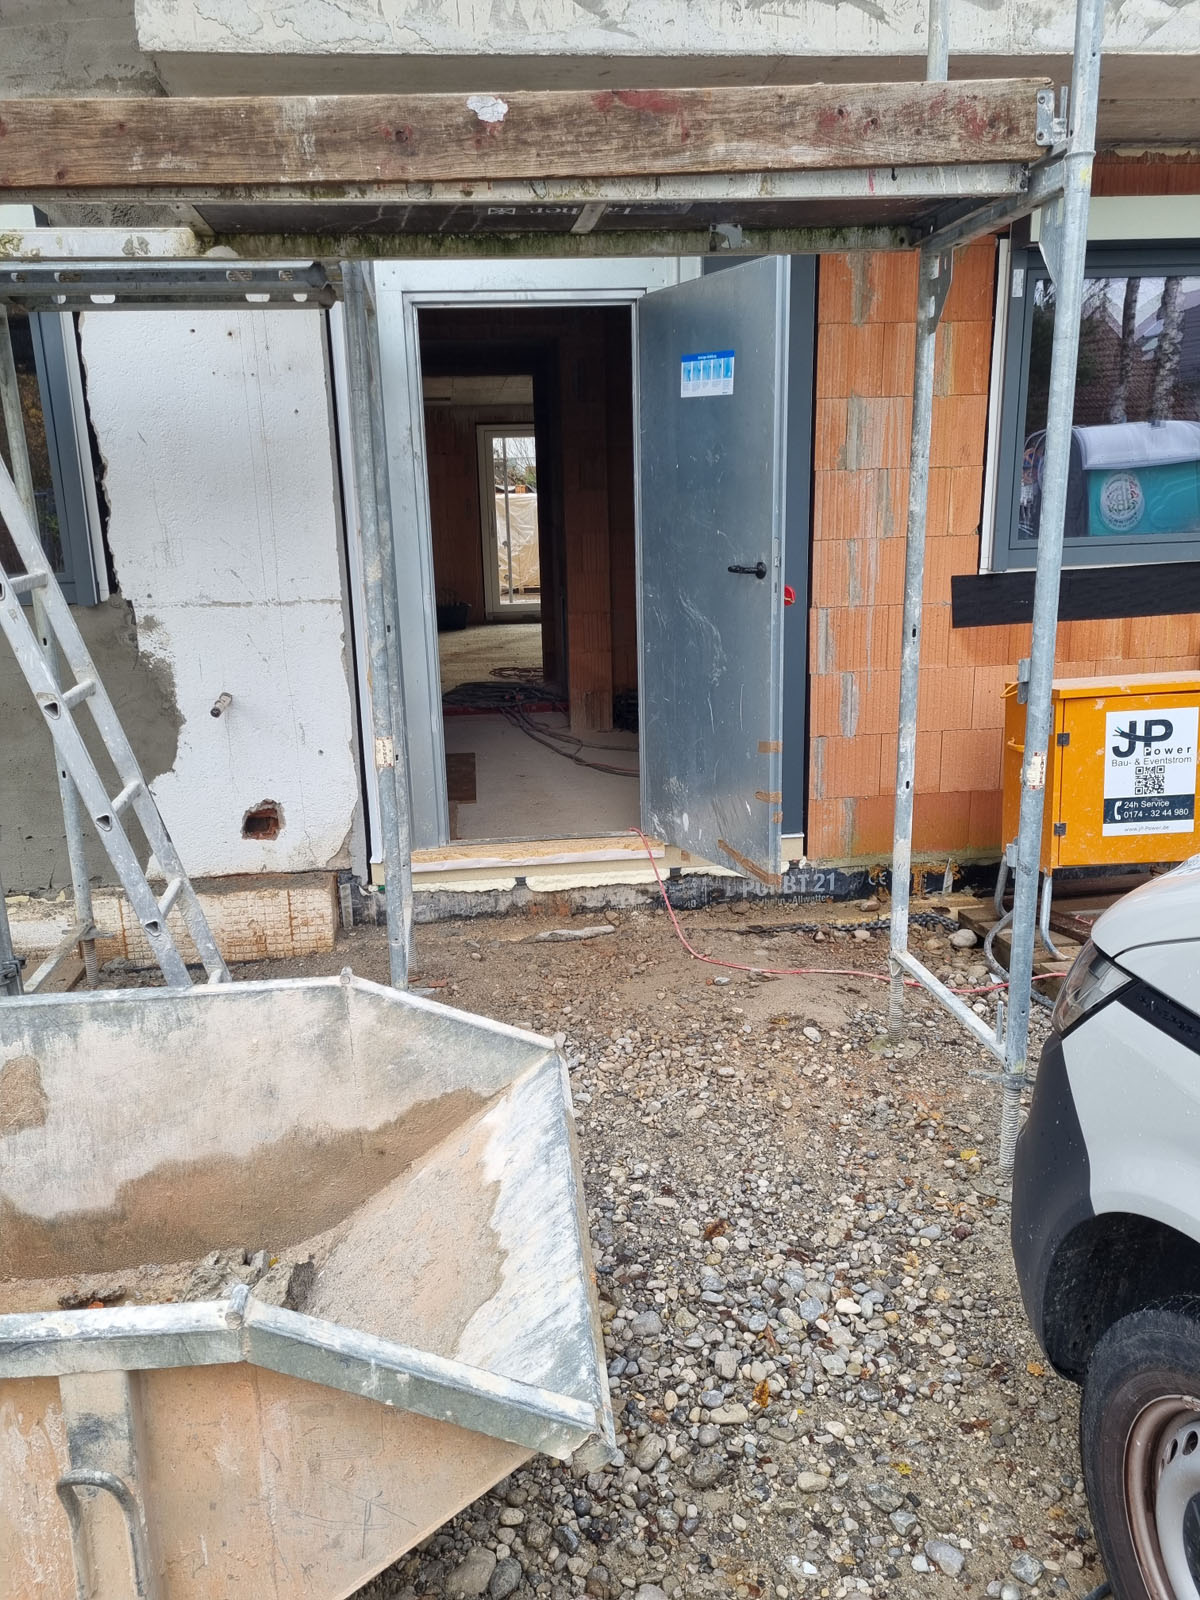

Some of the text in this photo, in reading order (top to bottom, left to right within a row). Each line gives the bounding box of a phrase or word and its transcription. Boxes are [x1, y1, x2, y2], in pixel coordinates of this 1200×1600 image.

[1112, 719, 1173, 758] JP
[1143, 746, 1192, 756] Power
[1111, 757, 1192, 767] Bau- & Eventstrom
[1124, 800, 1170, 809] 24h Service
[1123, 810, 1143, 819] 0174
[1150, 809, 1161, 817] 32
[1162, 808, 1172, 816] 44
[1173, 808, 1189, 816] 980
[783, 873, 810, 895] BT
[813, 872, 835, 893] 21
